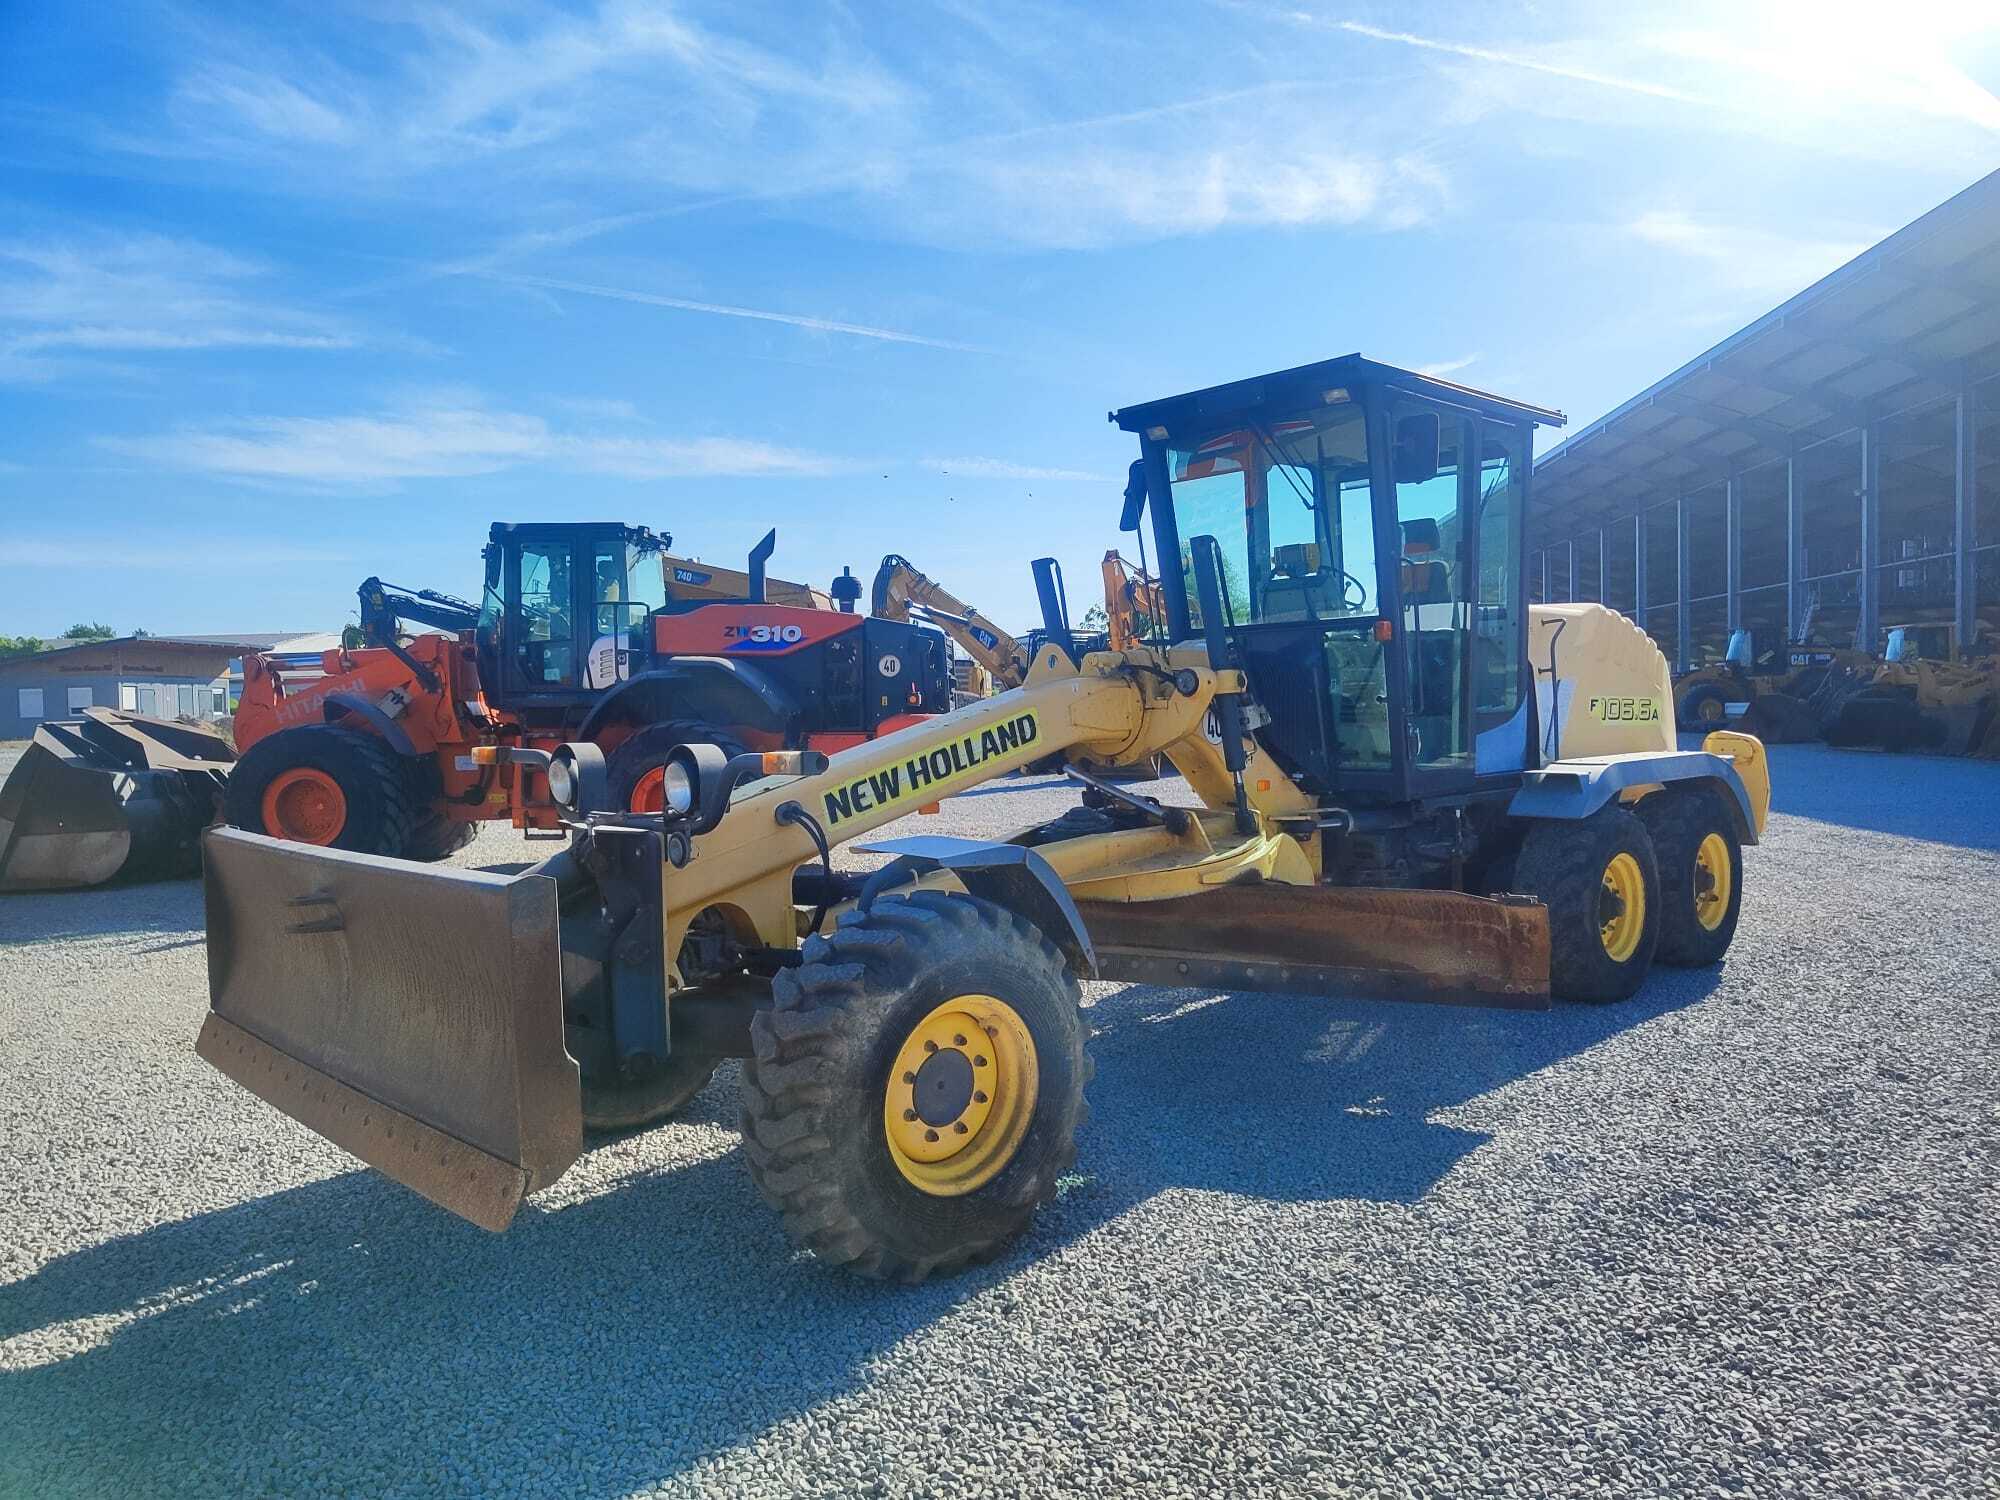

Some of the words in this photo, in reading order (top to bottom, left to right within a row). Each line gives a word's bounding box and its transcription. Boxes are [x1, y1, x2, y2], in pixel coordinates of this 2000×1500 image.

[676, 569, 692, 583] 740
[978, 630, 993, 649] CAT
[883, 660, 896, 673] 40
[1791, 654, 1809, 665] CAT
[824, 772, 901, 825] NEW
[906, 713, 1038, 791] HOLLAND
